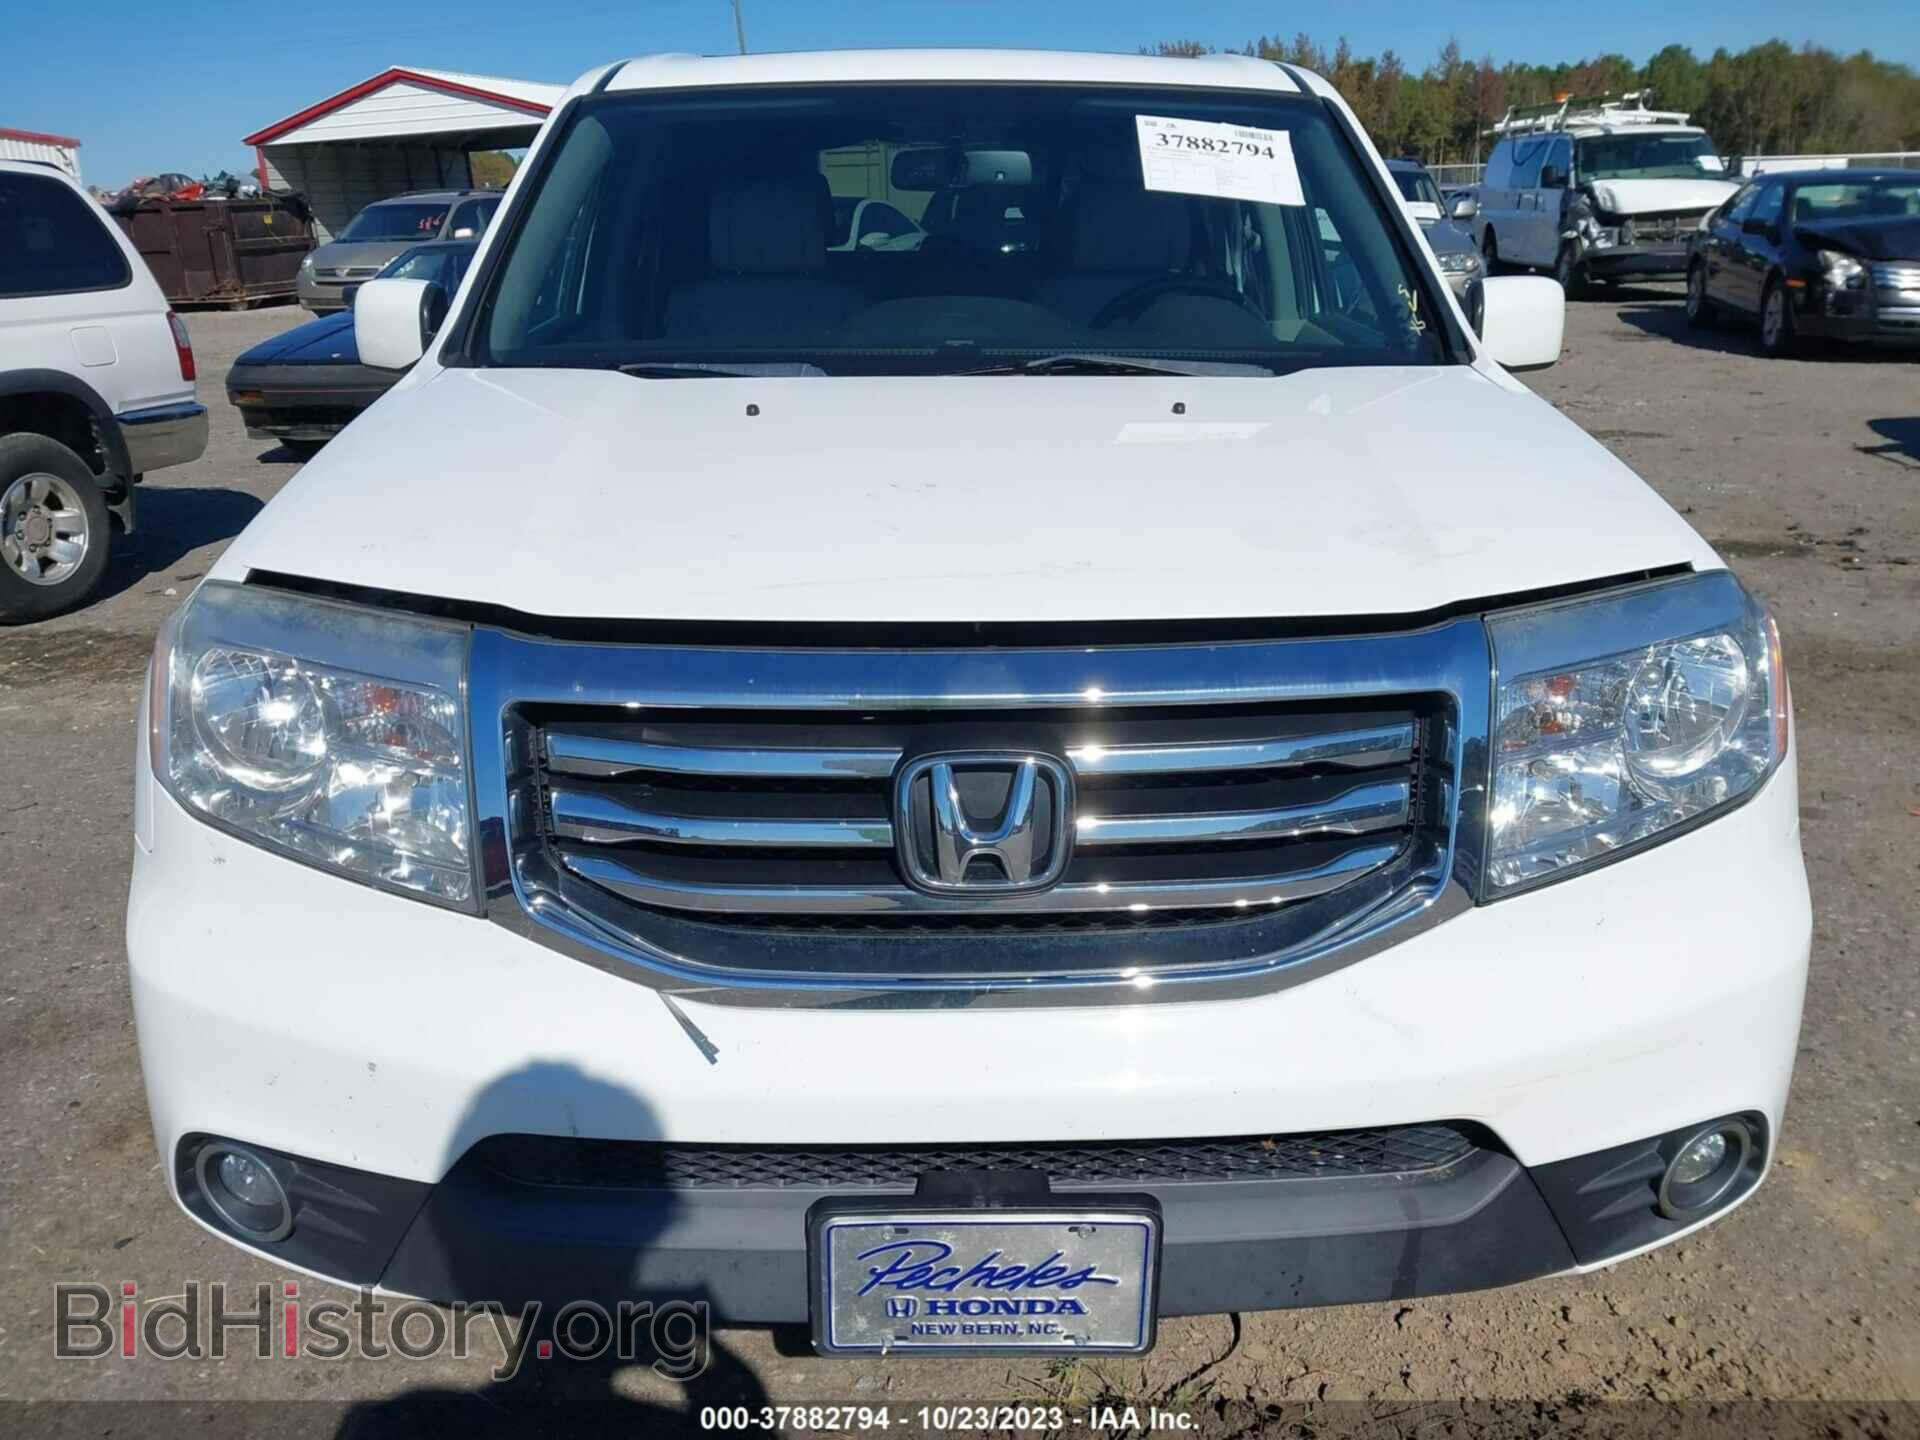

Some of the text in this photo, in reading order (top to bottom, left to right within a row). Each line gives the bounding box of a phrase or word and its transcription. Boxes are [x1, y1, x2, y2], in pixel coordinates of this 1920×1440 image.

[1155, 132, 1275, 160] 37882794
[924, 1299, 1087, 1316] HONDA
[911, 1322, 957, 1335] NEW
